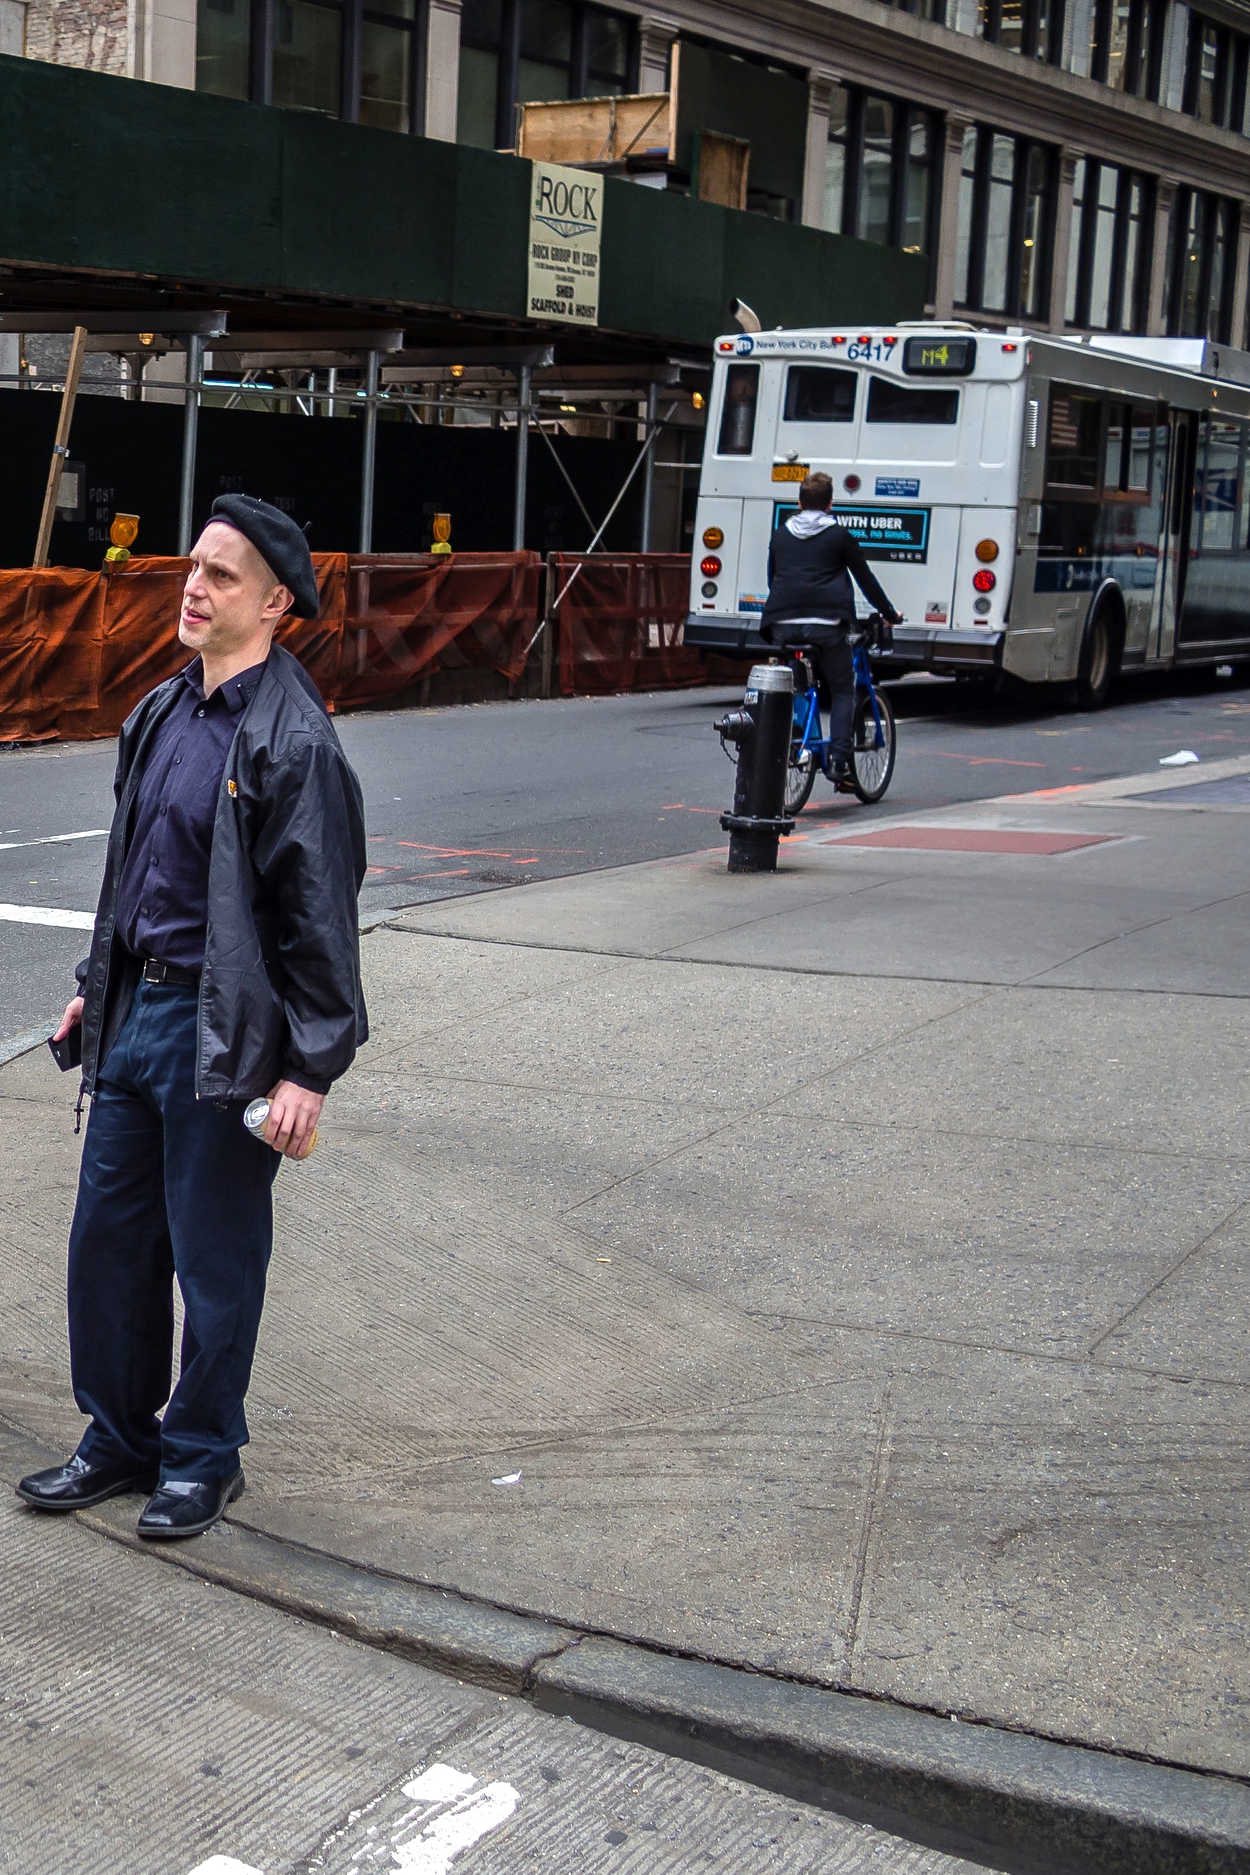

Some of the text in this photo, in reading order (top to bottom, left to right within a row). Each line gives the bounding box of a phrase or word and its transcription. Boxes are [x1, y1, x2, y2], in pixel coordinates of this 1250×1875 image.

[538, 175, 597, 221] ROCK
[532, 243, 549, 260] ROCK
[551, 246, 571, 263] GROUP
[556, 284, 574, 299] SHED
[531, 297, 566, 314] SCAFFOLD
[575, 303, 596, 319] HOIST
[756, 340, 775, 350] New
[777, 340, 796, 349] York
[799, 339, 818, 351] City
[847, 342, 894, 361] 6417
[921, 343, 949, 366] M4
[89, 487, 115, 503] POST
[836, 514, 902, 529] WITH UBER
[88, 527, 110, 542] BILL
